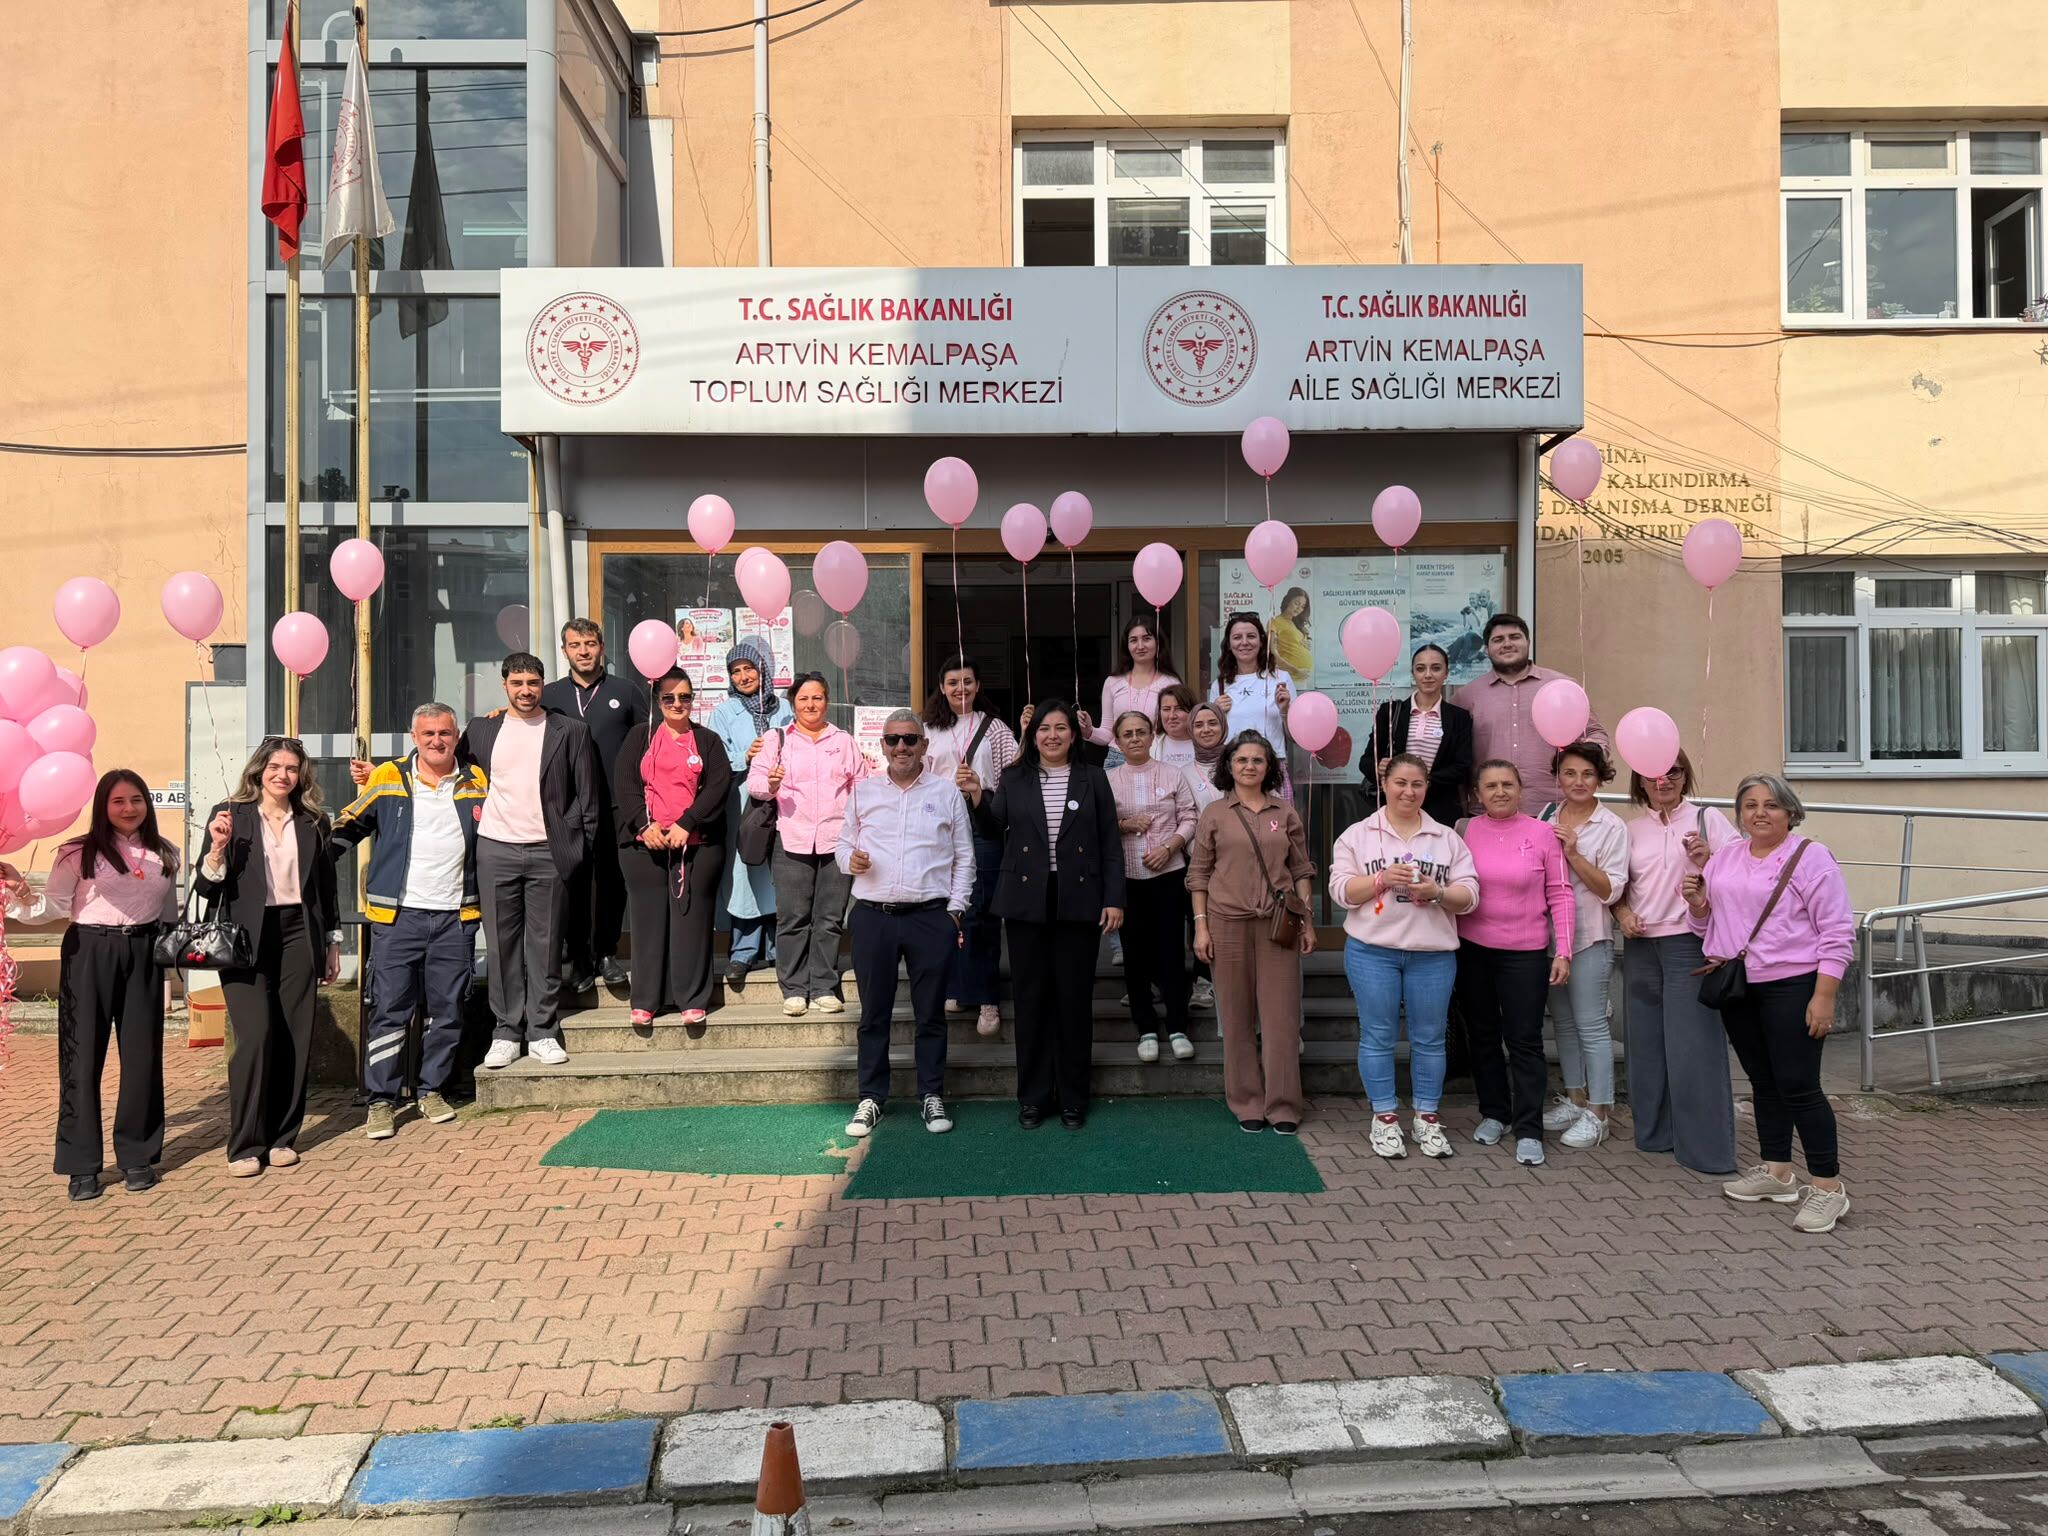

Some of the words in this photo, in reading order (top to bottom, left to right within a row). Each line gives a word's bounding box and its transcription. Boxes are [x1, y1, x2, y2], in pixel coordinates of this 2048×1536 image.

[738, 298, 782, 321] T.C.
[788, 293, 874, 321] SAĞLIK
[881, 293, 1012, 321] BAKANLIĞI
[1321, 295, 1354, 318] T.C.
[1358, 290, 1424, 318] SAĞLIK
[1428, 289, 1527, 318] BAKANLIĞI
[593, 317, 616, 338] SAĞLIK
[600, 340, 620, 380] BAKANLIĞI
[735, 338, 838, 365] ARTVİN
[849, 342, 1018, 371] KEMALPAŞA
[1305, 335, 1392, 362] ARTVİN
[1403, 338, 1545, 367] KEMALPAŞA
[690, 380, 807, 403] TOPLUM
[817, 376, 928, 403] SAĞLIĞI
[939, 377, 1063, 403] MERKEZİ
[1289, 373, 1340, 401] AİLE
[1351, 371, 1445, 400] SAĞLIĞI
[1457, 372, 1560, 399] MERKEZİ
[1607, 472, 1751, 489] KALKINDIRMA
[1684, 493, 1773, 514] DERNEĞİ
[1583, 548, 1623, 564] 2005
